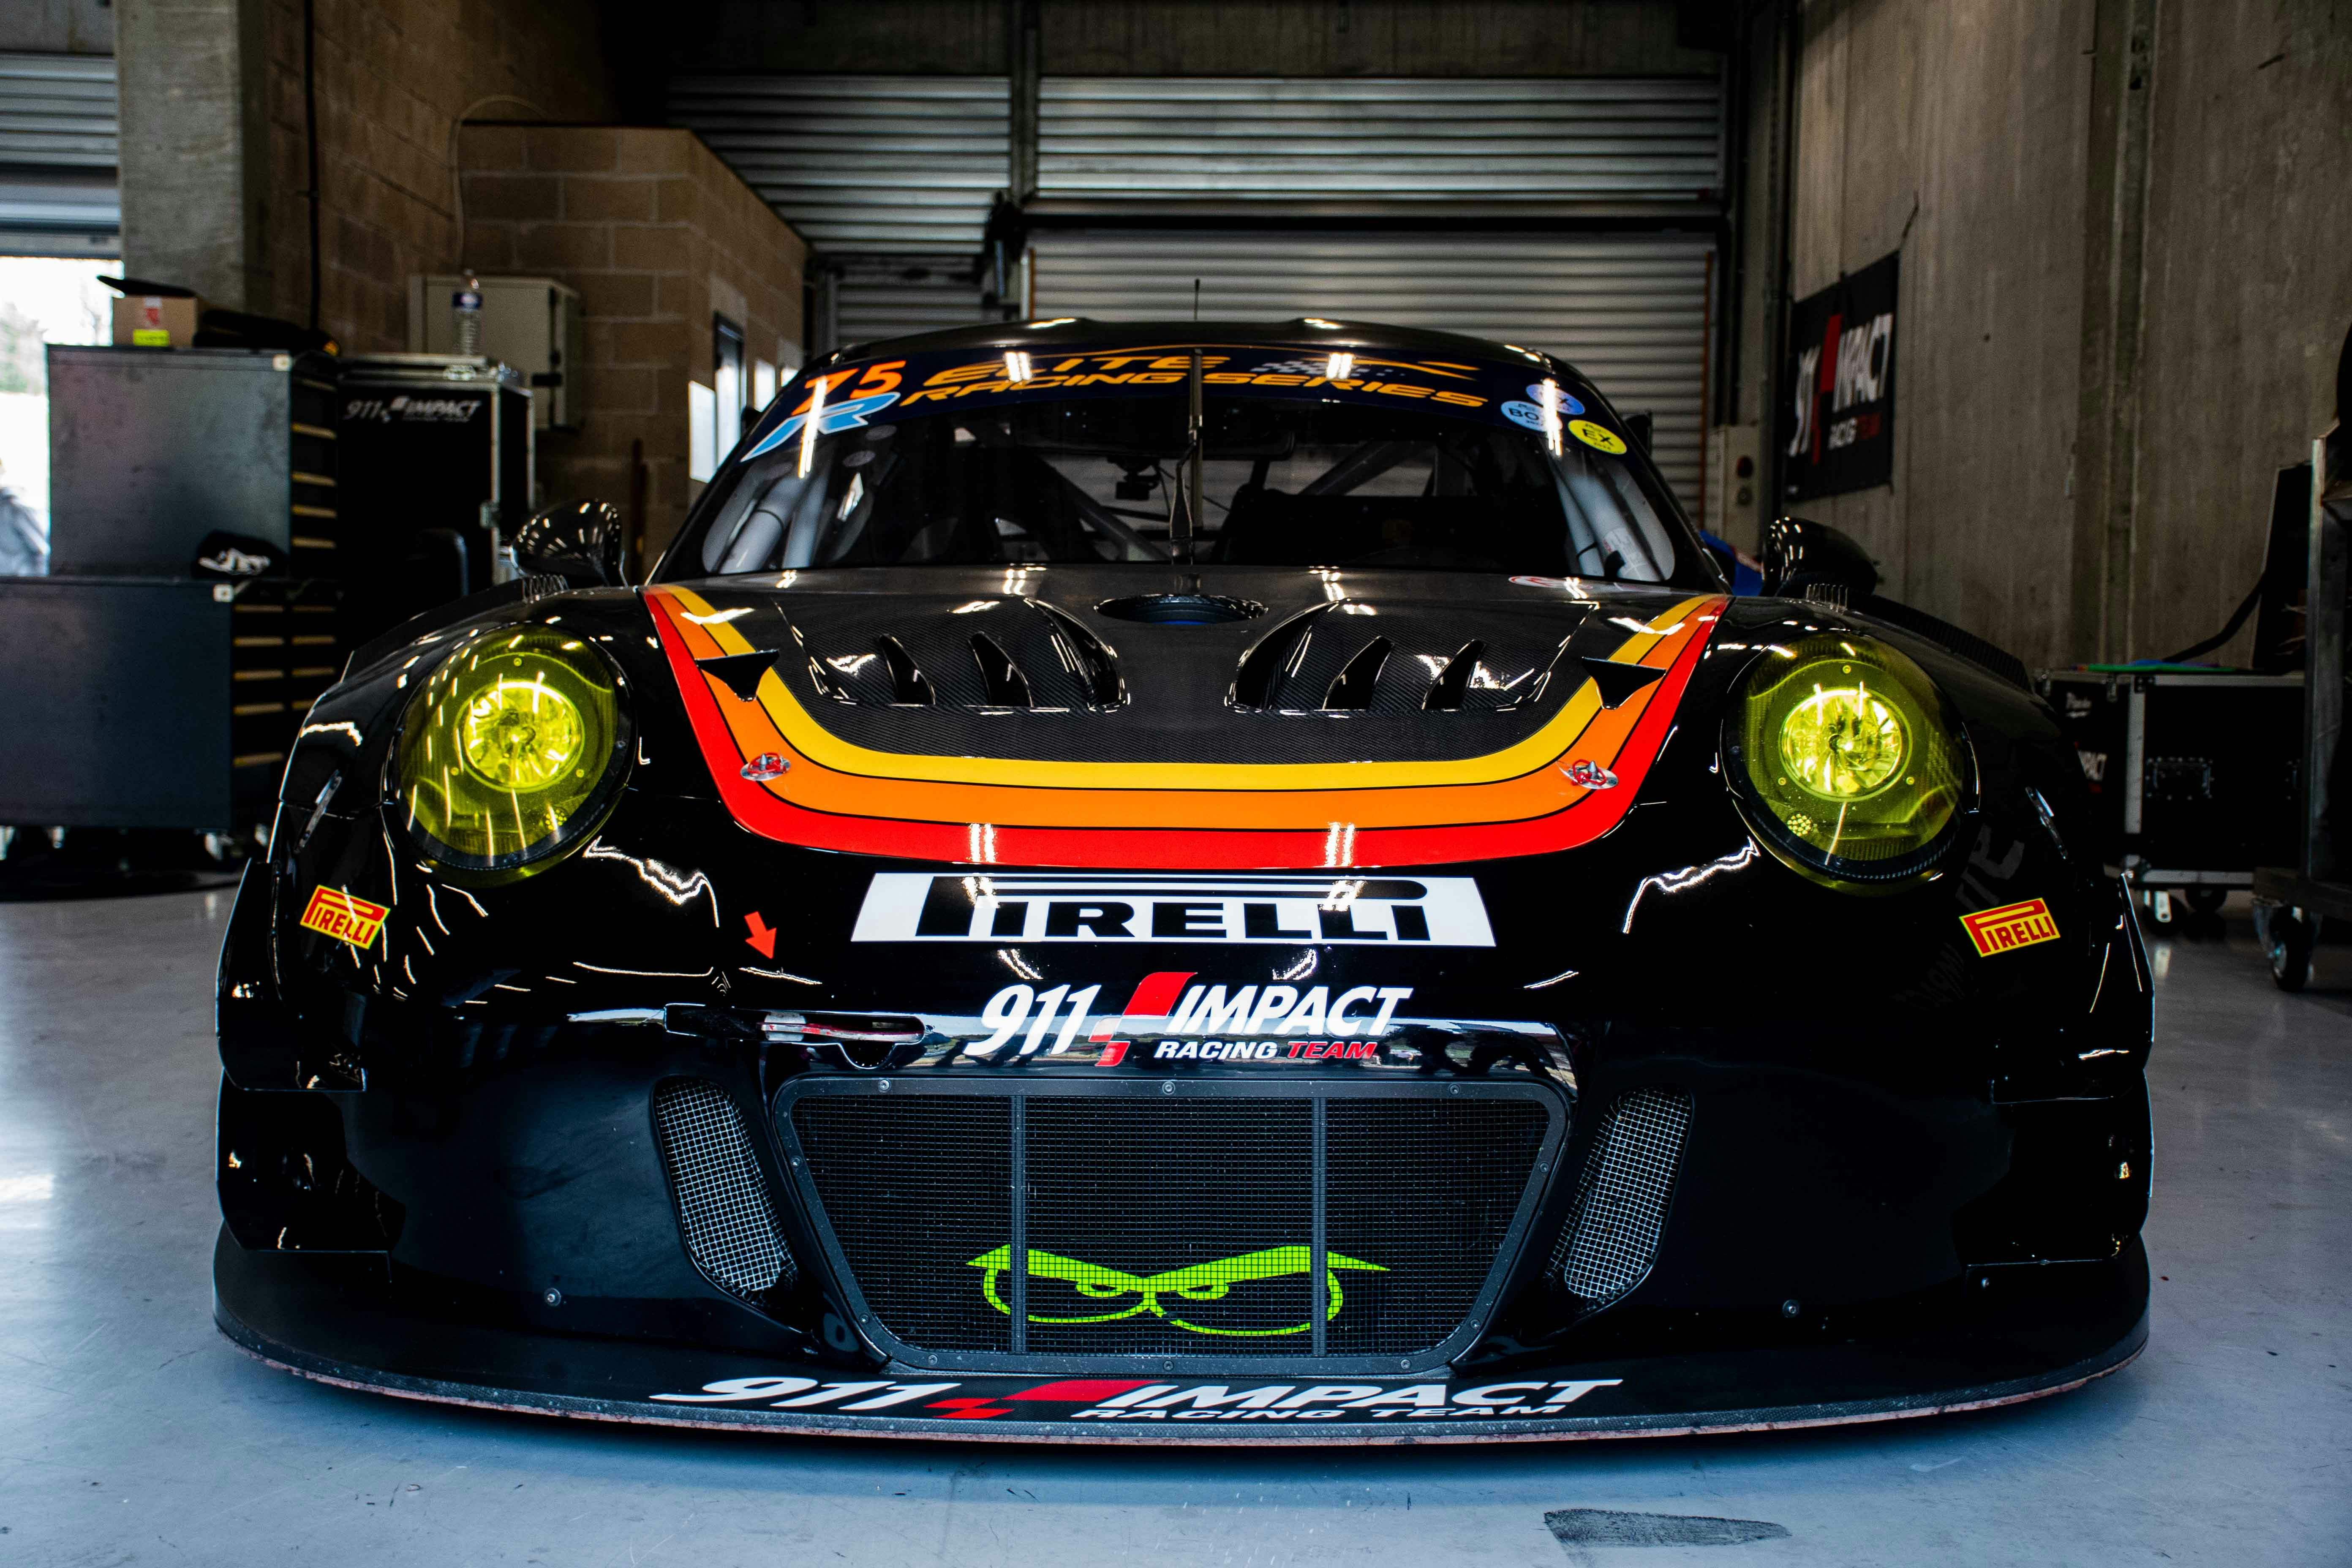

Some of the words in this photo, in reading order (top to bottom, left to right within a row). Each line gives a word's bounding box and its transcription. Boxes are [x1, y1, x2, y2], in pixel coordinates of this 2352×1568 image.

[791, 360, 906, 416] 75
[899, 372, 1187, 406] RACING
[1202, 372, 1488, 407] SERIES
[304, 888, 385, 945] PIRELLI
[915, 876, 1428, 939] PIRELLI
[1963, 900, 2056, 954] PIRELLI
[963, 984, 1102, 1056] 911
[1165, 985, 1414, 1037] IMPACT
[1154, 1041, 1277, 1060] RACING
[1287, 1041, 1378, 1059] TEAM
[649, 1377, 961, 1410] 911
[1096, 1379, 1623, 1408] IMPACT
[1070, 1410, 1345, 1419] RACING
[1370, 1405, 1566, 1418] TEAM
